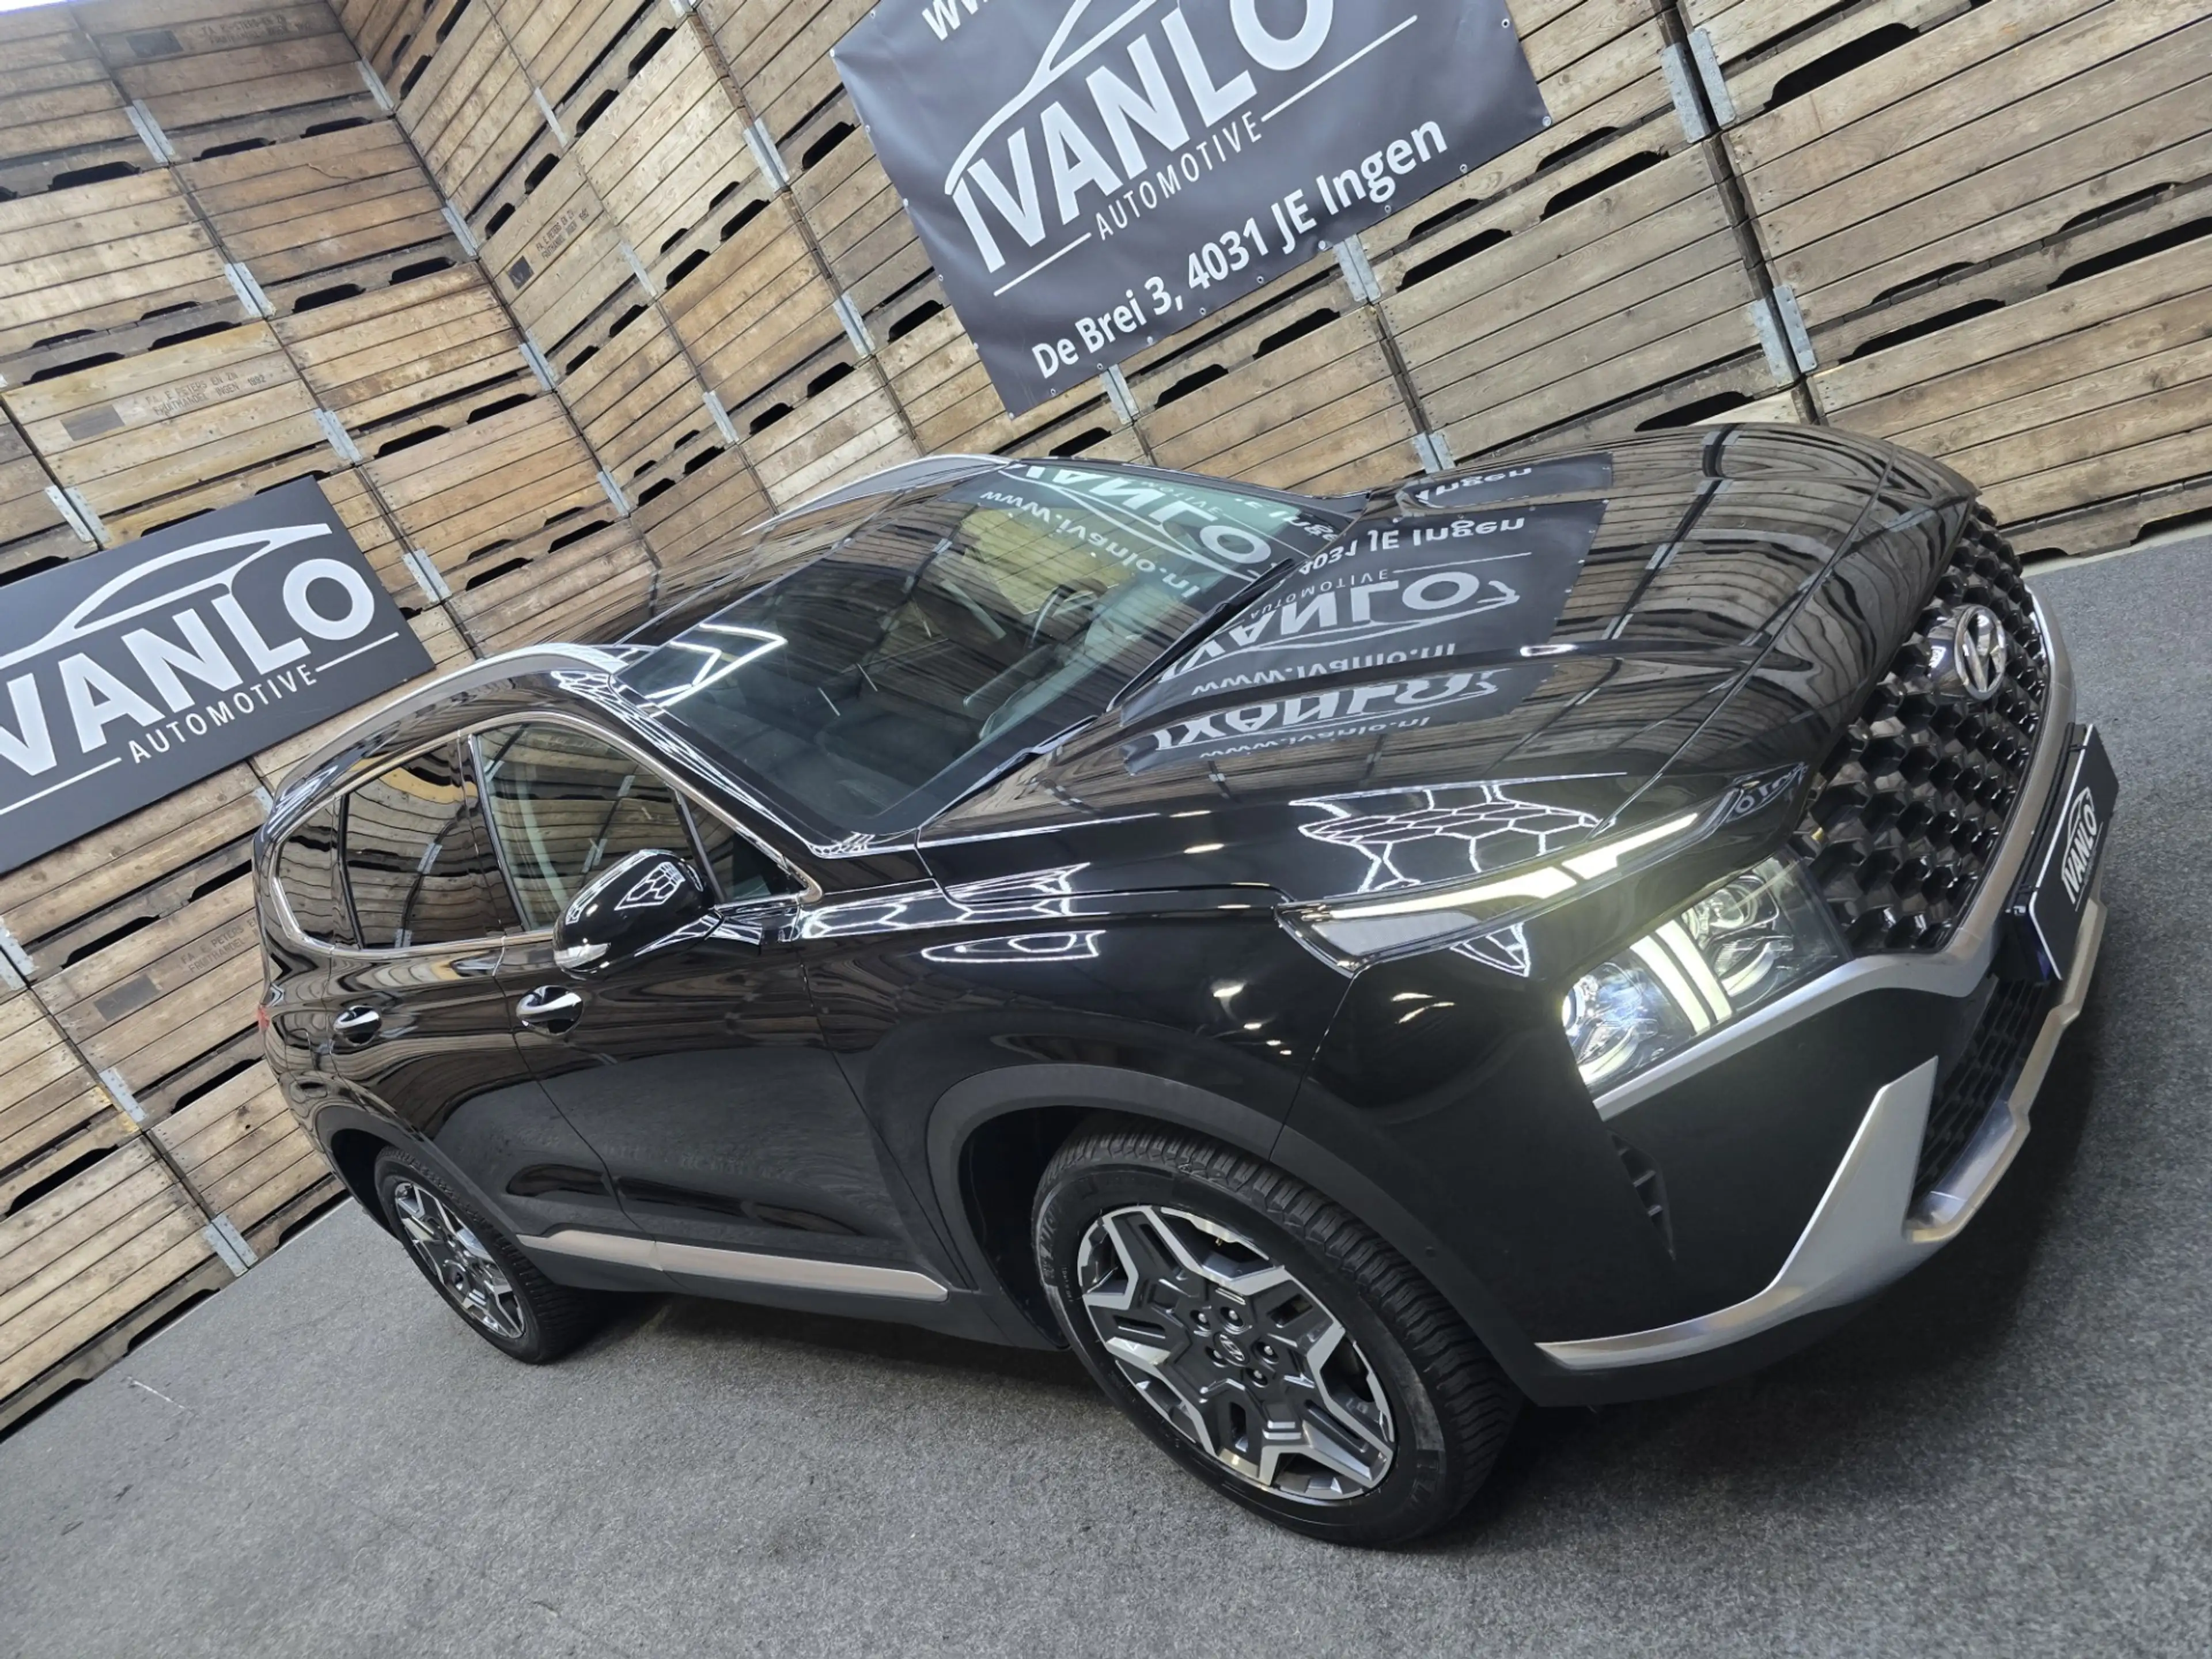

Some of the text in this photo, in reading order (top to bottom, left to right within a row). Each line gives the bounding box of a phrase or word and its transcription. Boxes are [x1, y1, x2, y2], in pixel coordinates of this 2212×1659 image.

[953, 0, 1332, 272] IVANLO
[1096, 111, 1262, 240] AUTOMOTIVE
[1032, 120, 1448, 378] De Brei 3, 4031 JE Ingen
[127, 664, 316, 764] AUTOMOTIVE
[2063, 804, 2097, 904] IVANLO
